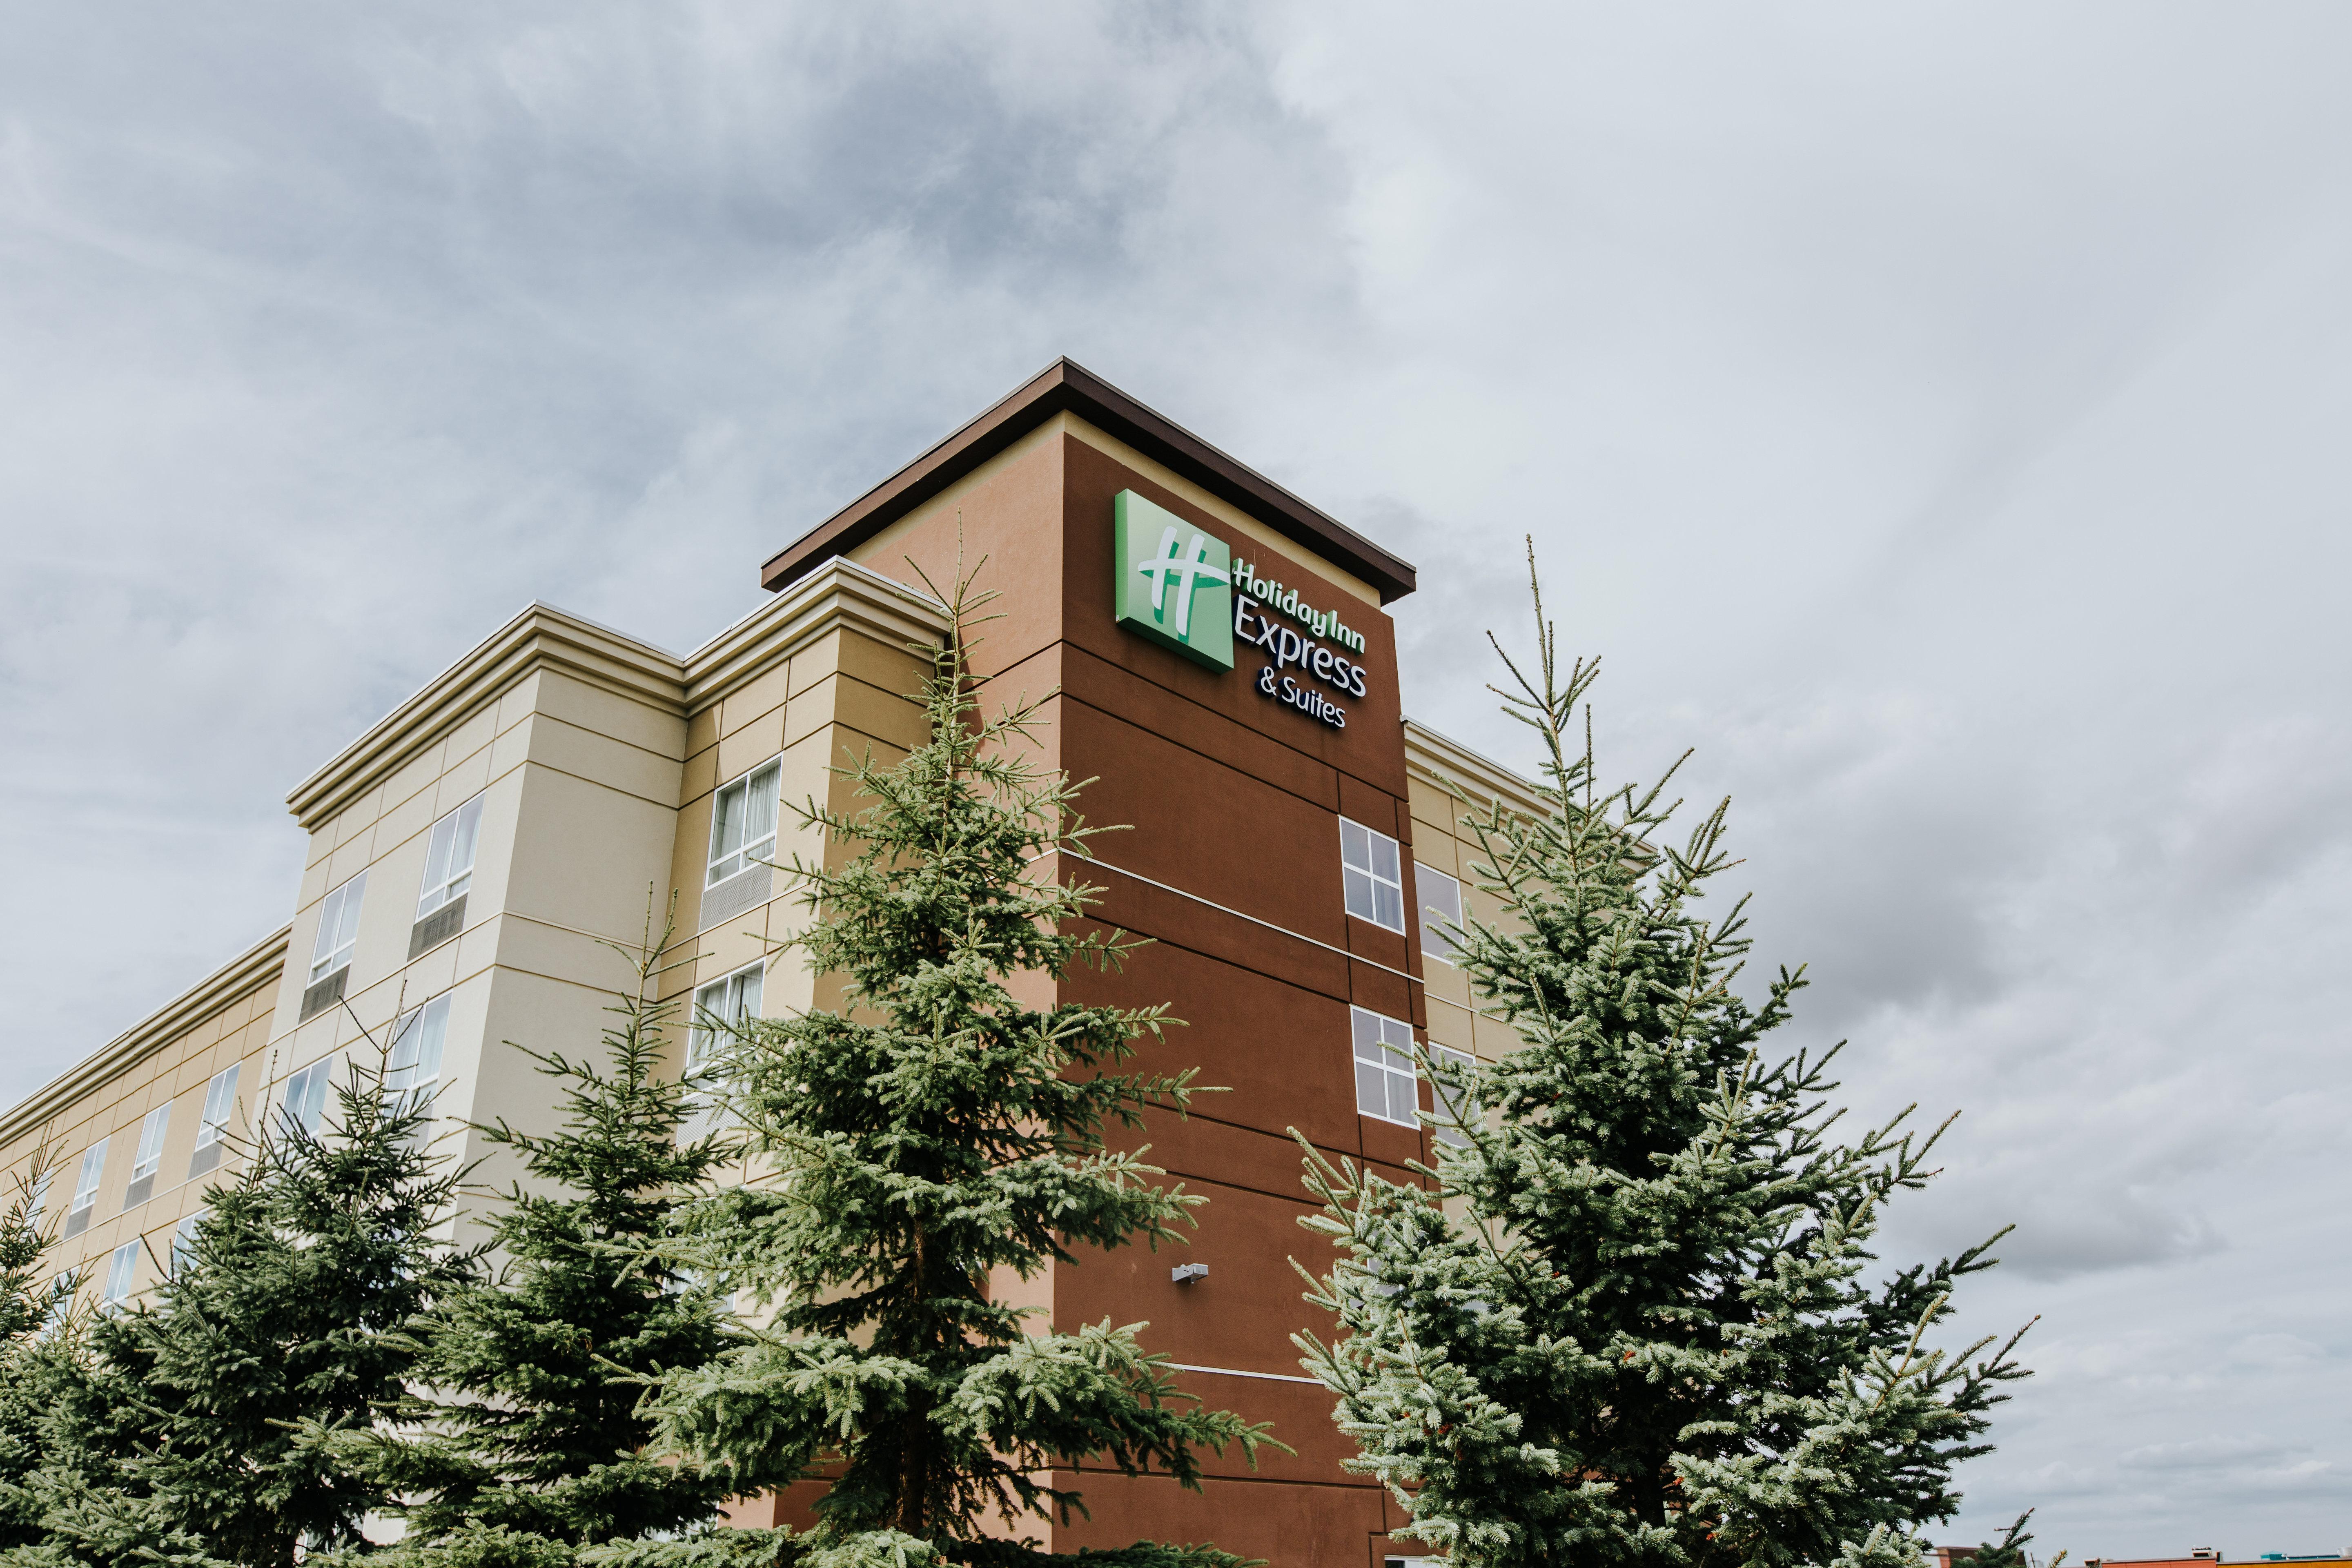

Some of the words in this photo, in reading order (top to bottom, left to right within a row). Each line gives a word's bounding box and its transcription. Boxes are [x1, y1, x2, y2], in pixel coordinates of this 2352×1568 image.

[1234, 558, 1327, 637] Holiday
[1330, 610, 1365, 654] Inn
[1235, 595, 1366, 697] Express
[1261, 666, 1277, 696] &
[1282, 677, 1345, 728] Suites
